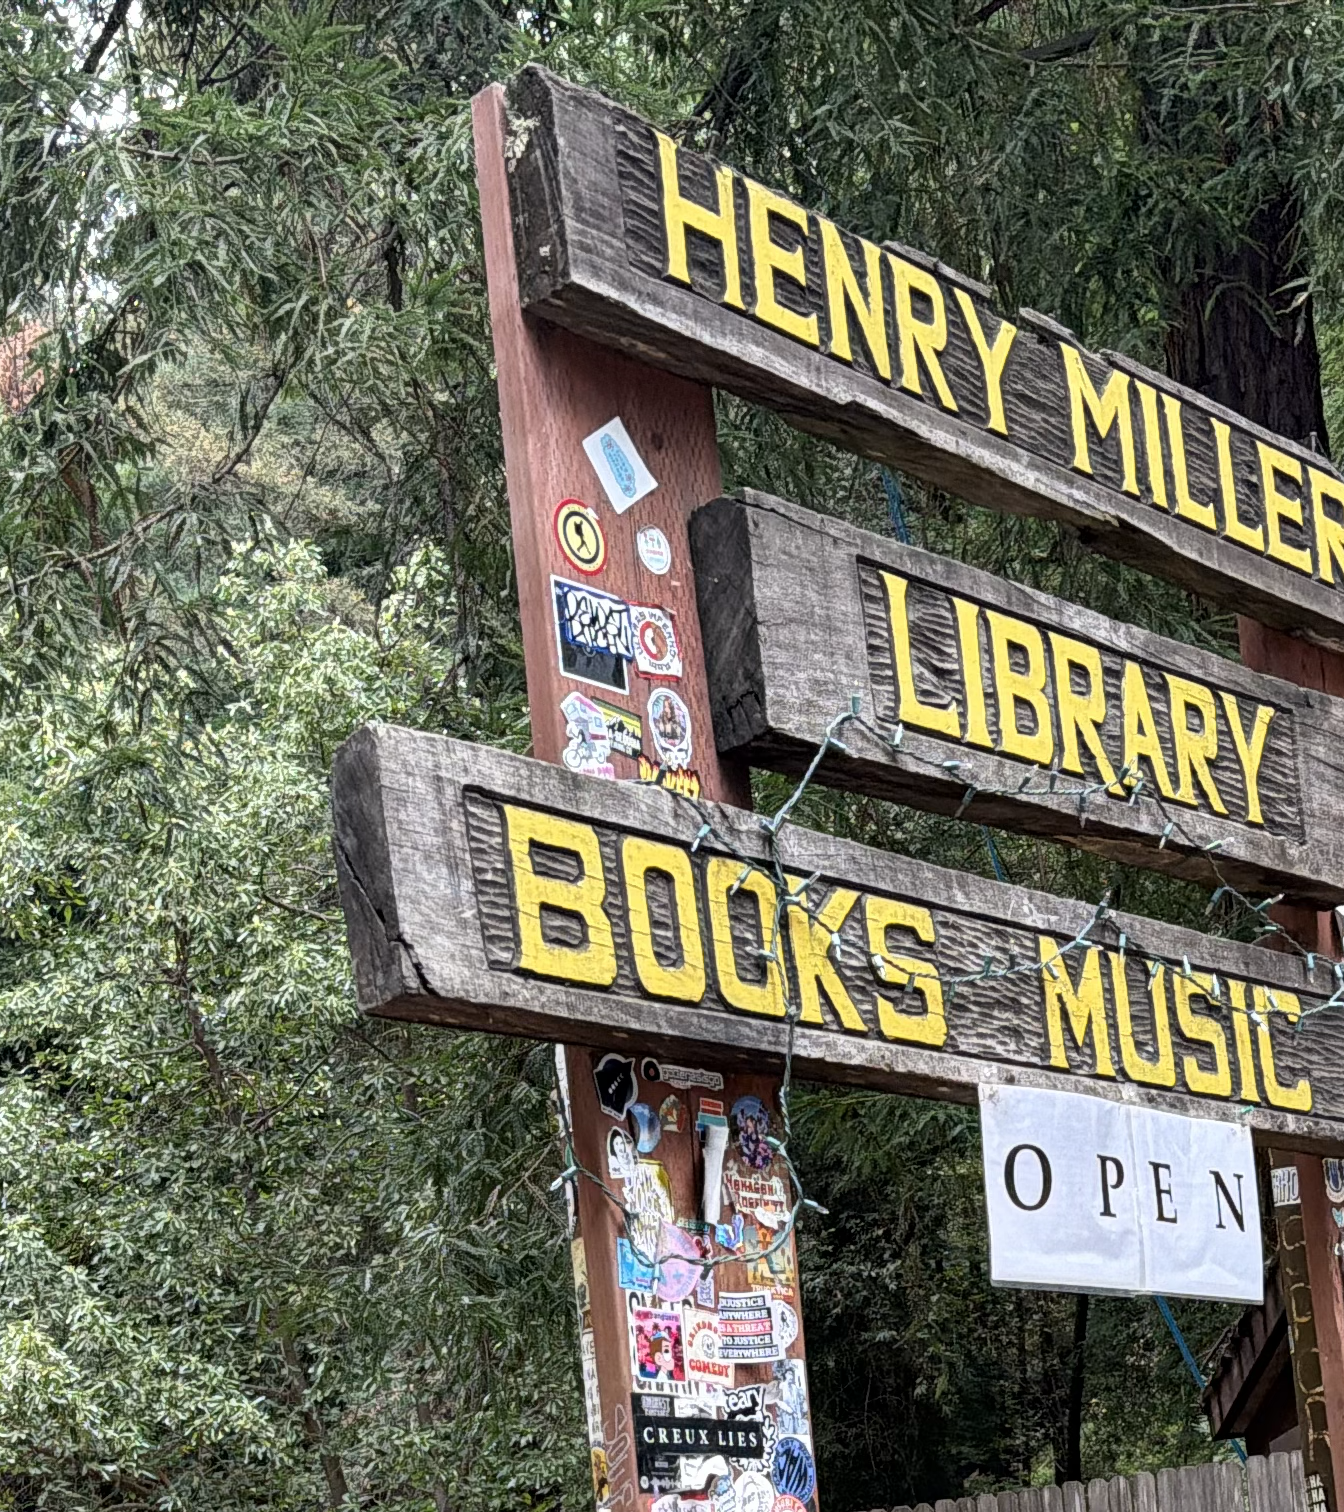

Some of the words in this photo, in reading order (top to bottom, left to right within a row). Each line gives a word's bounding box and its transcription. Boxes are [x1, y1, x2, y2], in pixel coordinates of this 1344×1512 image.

[654, 131, 1016, 437] HENRY
[880, 569, 1279, 825] LIBRARY
[504, 803, 949, 1049] BOOKS
[1039, 933, 1314, 1114] MUSIC
[1004, 1143, 1246, 1232] OPEN
[732, 1322, 771, 1332] THREAT
[723, 1336, 732, 1344] TO
[734, 1335, 771, 1344] JUSTICE
[719, 1347, 778, 1357] EVERYWHERE
[689, 1359, 730, 1378] COMEDY
[643, 1427, 709, 1444] CREUX
[718, 1431, 758, 1447] LIES
